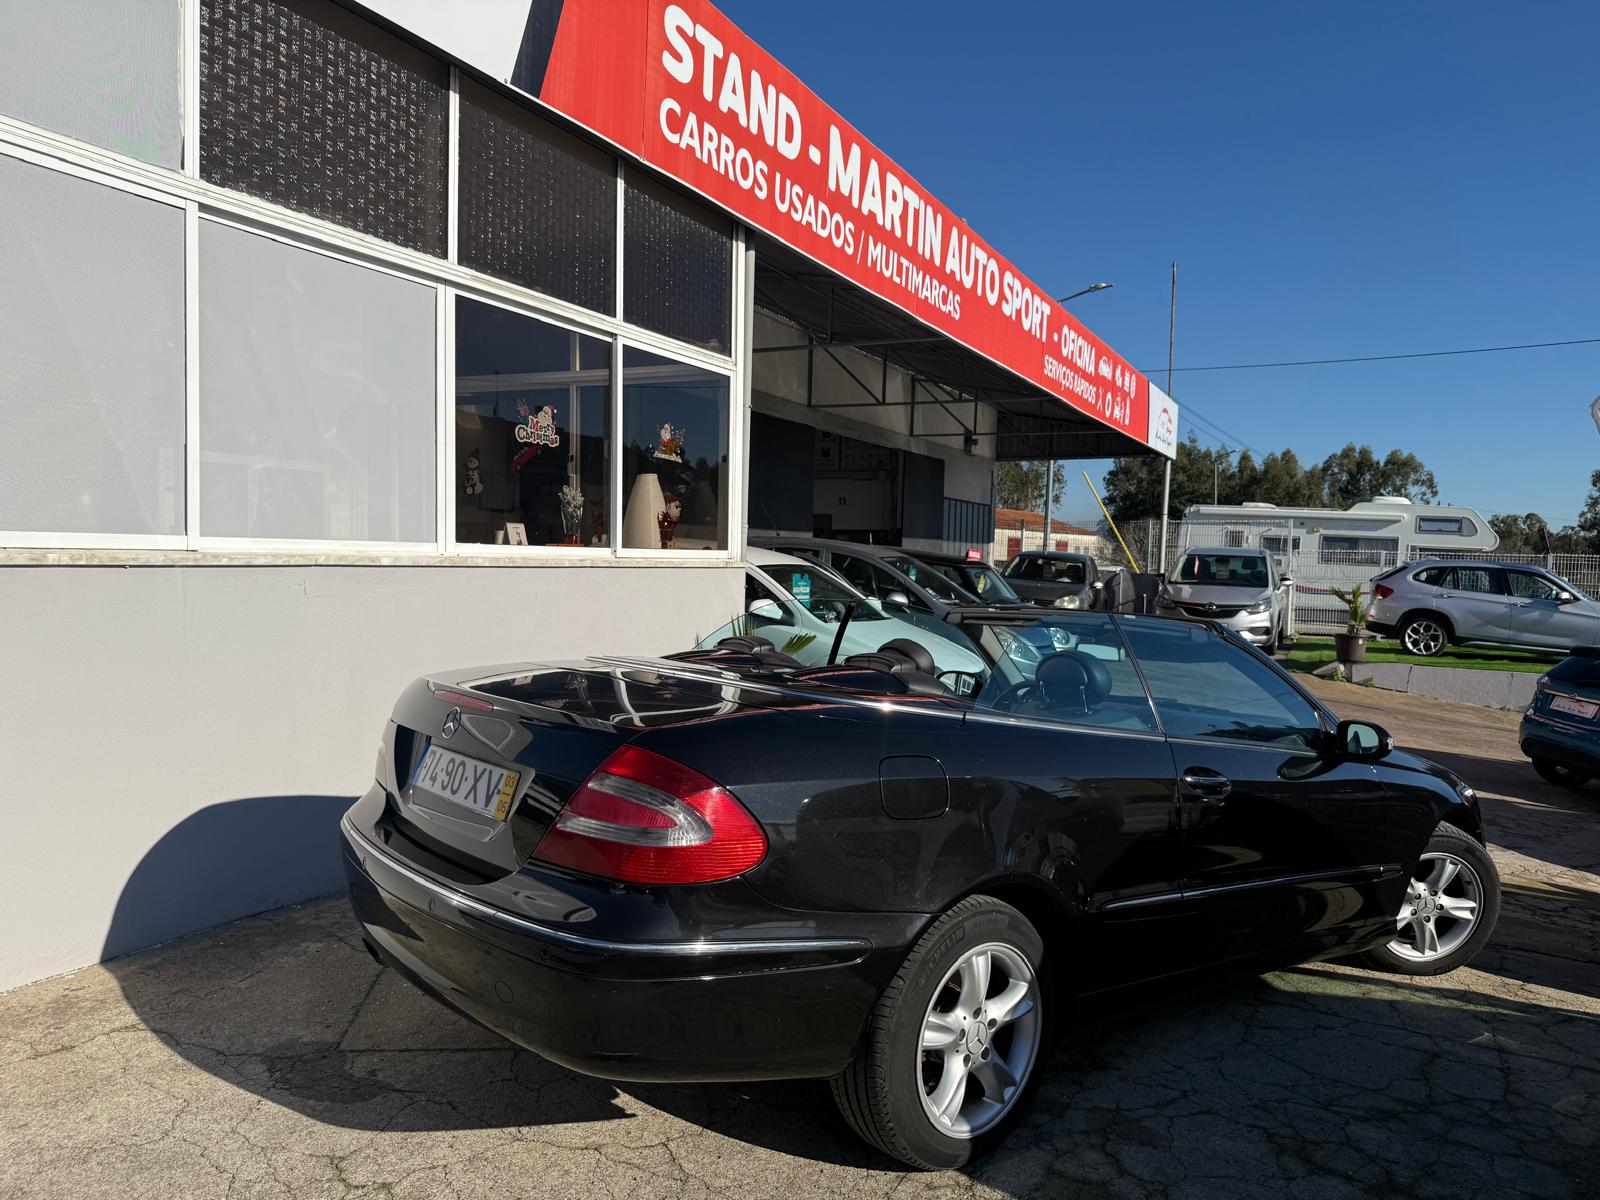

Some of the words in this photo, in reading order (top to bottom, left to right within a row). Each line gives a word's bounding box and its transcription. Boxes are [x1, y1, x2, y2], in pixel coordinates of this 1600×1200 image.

[659, 97, 768, 200] CARROS
[774, 171, 855, 256] USADOS
[867, 235, 961, 321] MULTIMARCAS
[661, 4, 801, 160] STAND
[827, 124, 943, 267] MARTIN
[944, 226, 1000, 306] AUTO
[1001, 270, 1051, 343] SPORT
[1061, 324, 1096, 377] OFICINA
[1043, 354, 1075, 391] SERVIÇOS
[516, 426, 560, 446] Christmas
[529, 416, 555, 436] Merry
